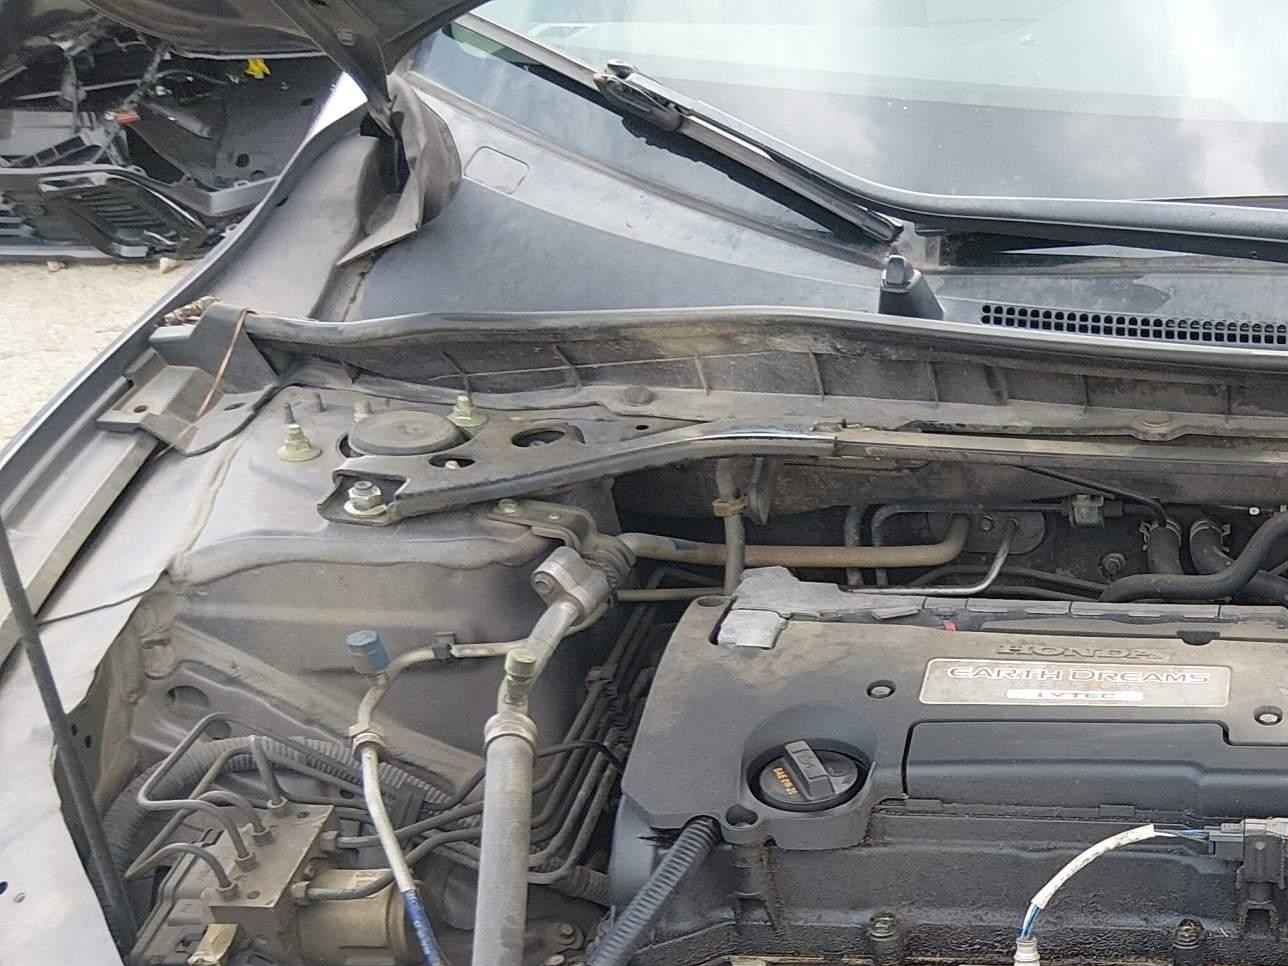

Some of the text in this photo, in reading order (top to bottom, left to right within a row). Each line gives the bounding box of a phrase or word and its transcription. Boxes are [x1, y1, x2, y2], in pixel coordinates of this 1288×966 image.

[997, 645, 1163, 660] HONDA
[948, 666, 1211, 684] EARTH DREAMS
